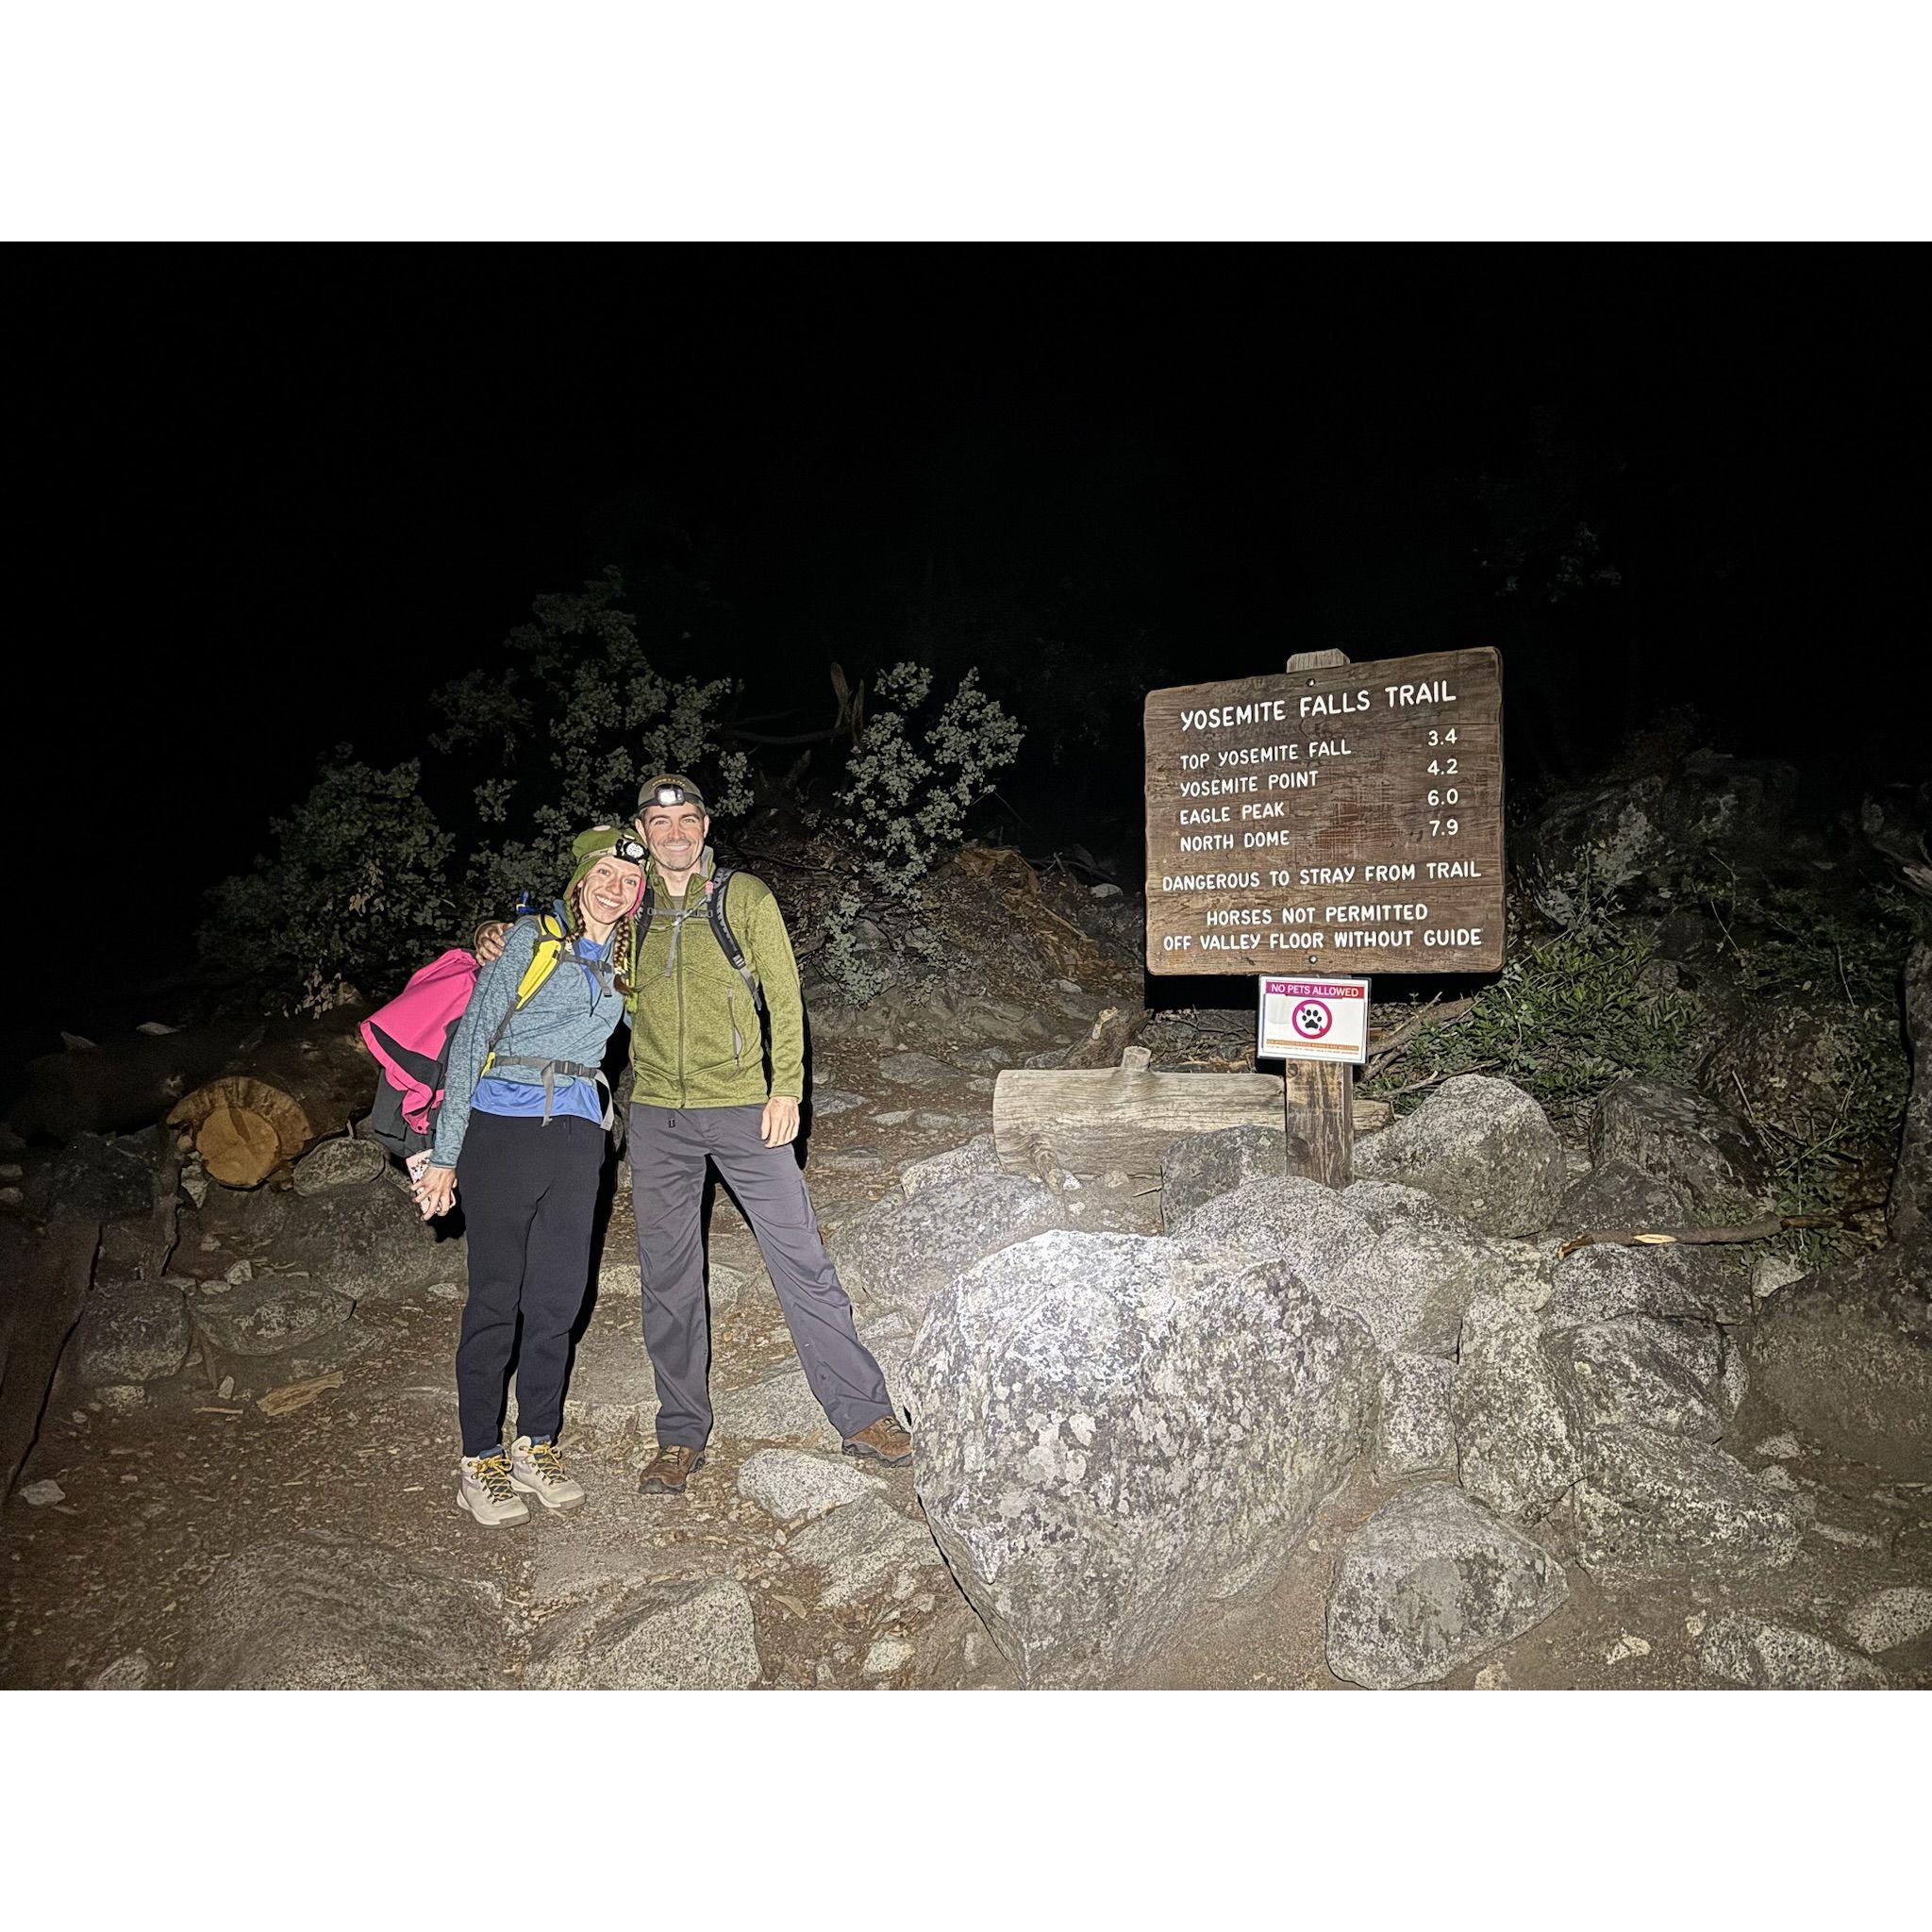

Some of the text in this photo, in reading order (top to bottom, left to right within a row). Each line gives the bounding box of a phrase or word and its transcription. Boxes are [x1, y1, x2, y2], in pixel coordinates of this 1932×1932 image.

[1180, 680, 1457, 732] YOSEMITE FALLS TRAIL
[1179, 727, 1458, 771] TOP YOSEMITE FALL 3.4
[1179, 758, 1458, 798] YOSEMITE POINT 4.2
[1179, 788, 1458, 825] EAGLE PEAK 6.0
[1180, 818, 1458, 853] NORTH DOME 7.9
[1162, 860, 1482, 892] DANGEROUS TO STRAY FROM TRAIL
[1207, 903, 1428, 926] HORSES NOT PERMITTED
[1163, 927, 1482, 952] OFF VALLEY FLOOR WITHOUT GUIDE
[1271, 983, 1358, 997] NO PETS ALLOWED
